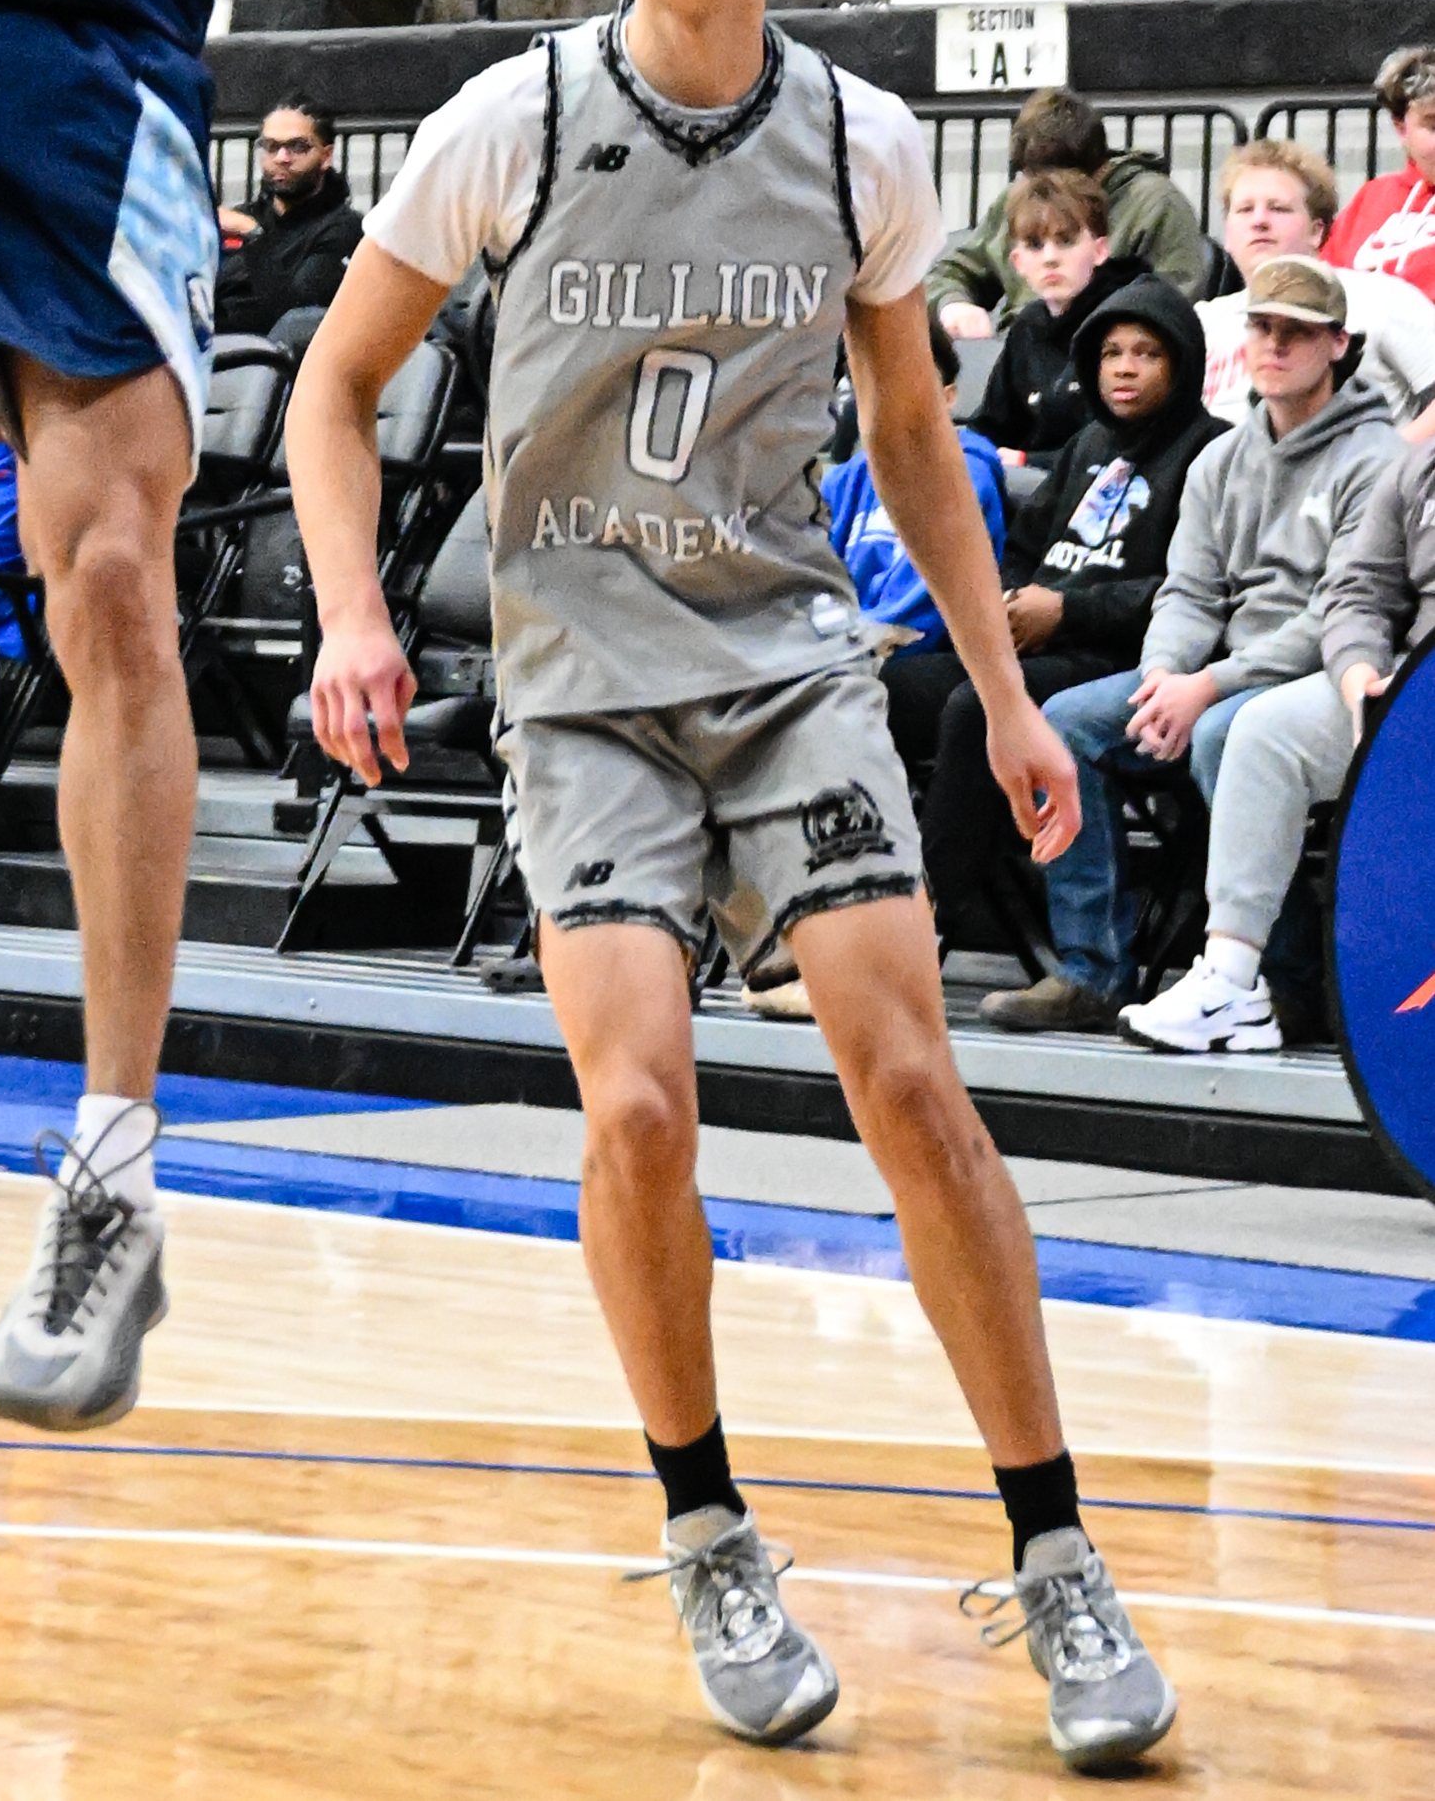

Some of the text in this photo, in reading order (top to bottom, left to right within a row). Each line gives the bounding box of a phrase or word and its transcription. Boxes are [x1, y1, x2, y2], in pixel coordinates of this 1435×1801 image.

[967, 8, 1036, 32] SECTION
[991, 42, 1009, 86] A
[549, 259, 829, 329] GILLION
[626, 344, 718, 485] 0
[531, 496, 760, 563] ACADEM
